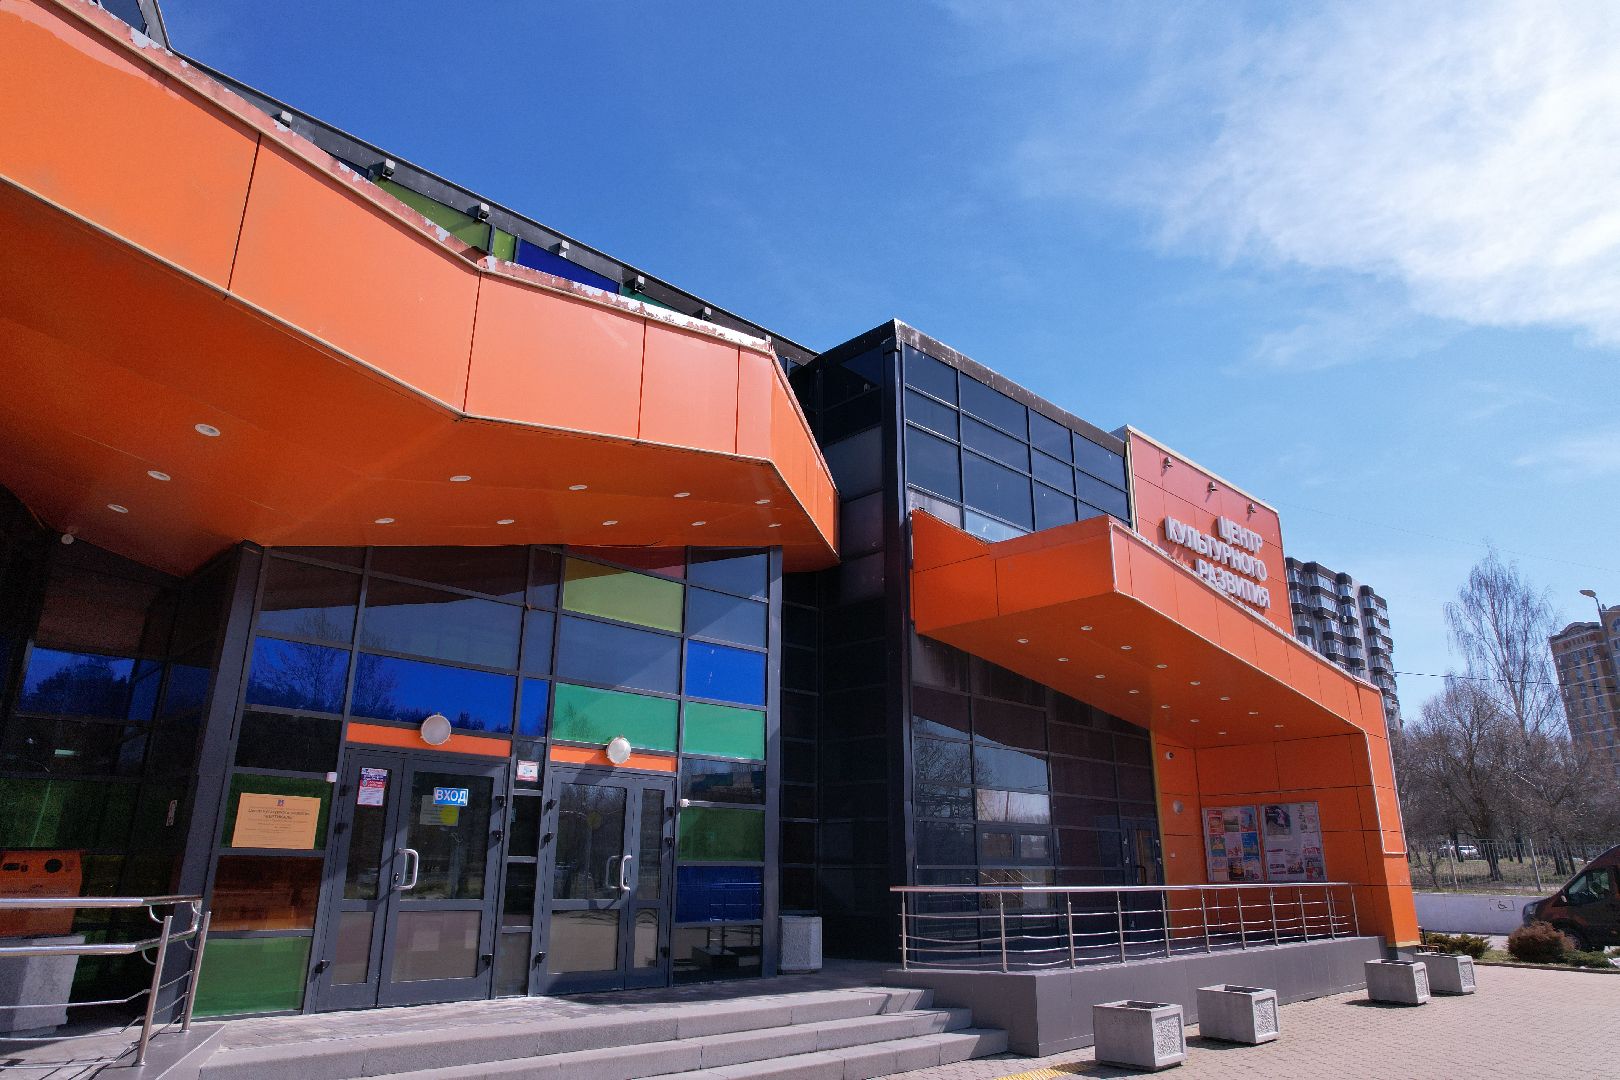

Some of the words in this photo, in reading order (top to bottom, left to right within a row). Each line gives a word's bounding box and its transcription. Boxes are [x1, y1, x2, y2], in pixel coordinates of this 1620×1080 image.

[1164, 515, 1268, 582] КУЛЬТУРНОГО
[1217, 515, 1263, 554] ЦЕНТР
[1195, 558, 1271, 609] РАЗВИТИЯ
[436, 790, 466, 804] ВХОД
